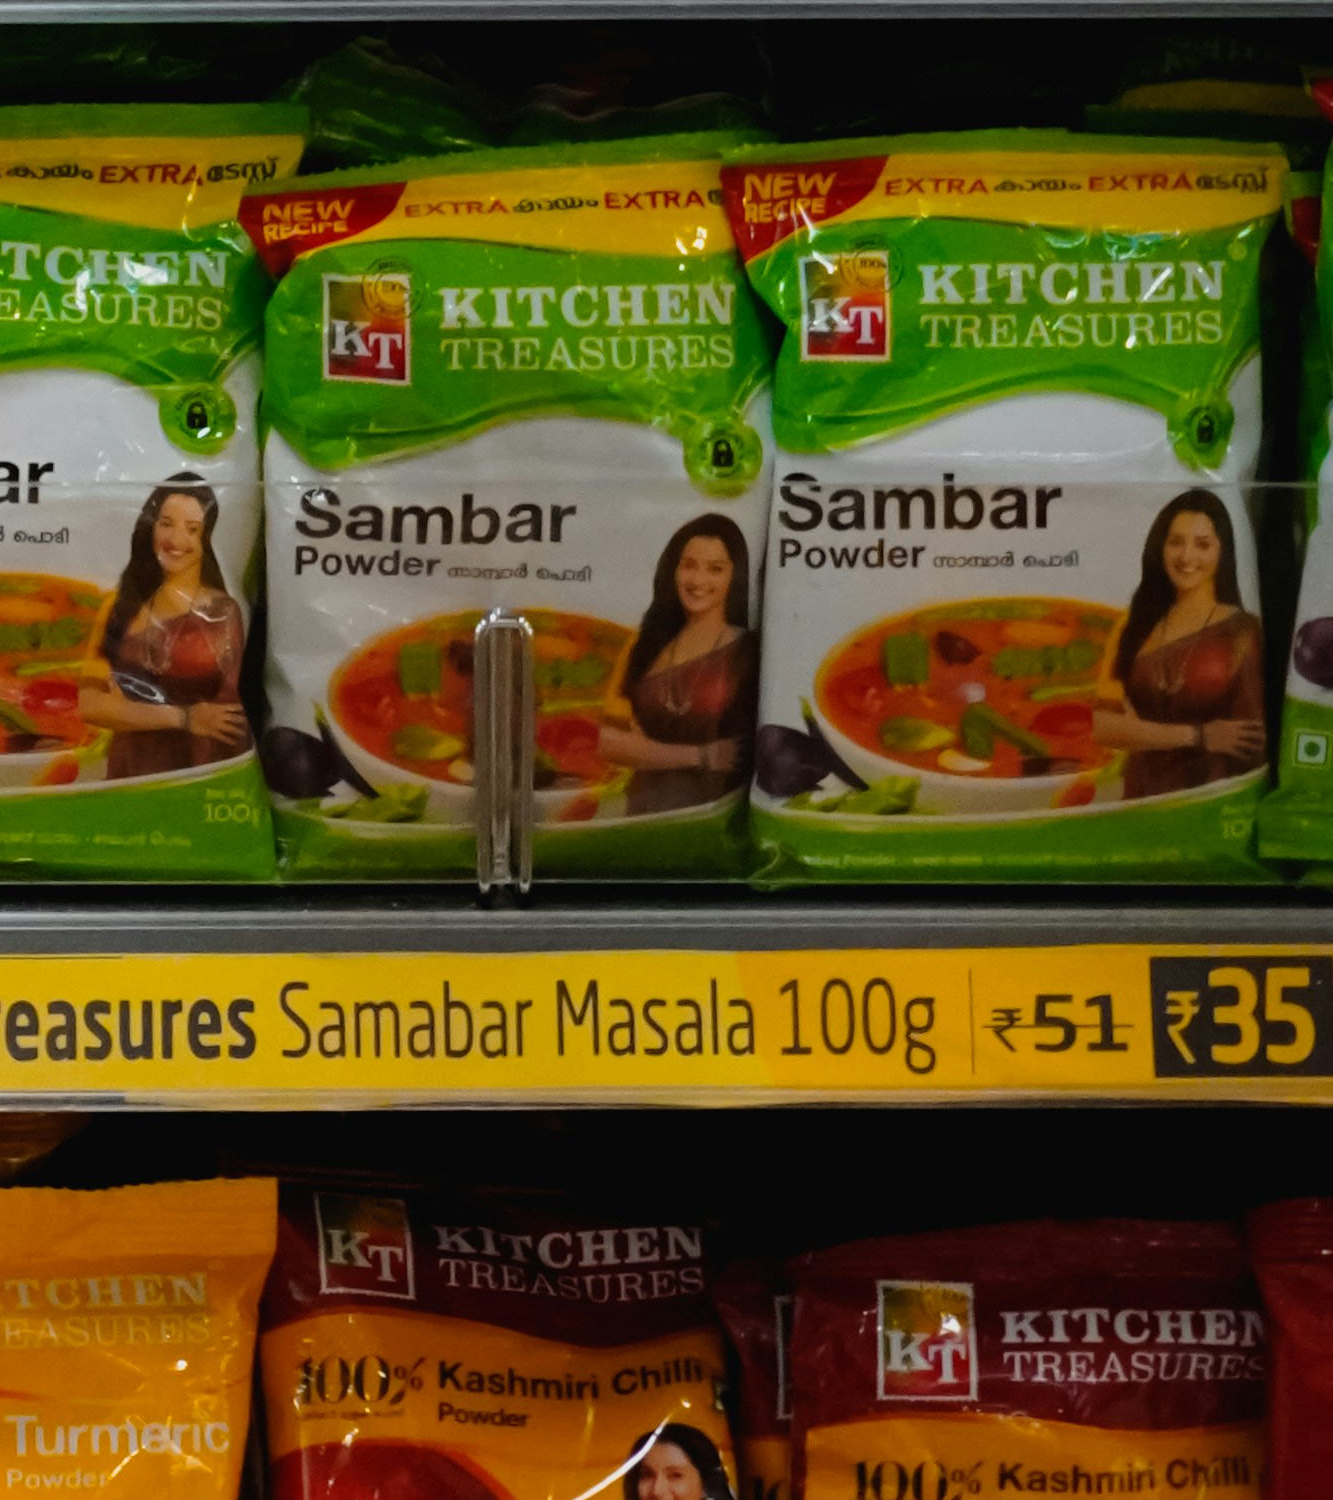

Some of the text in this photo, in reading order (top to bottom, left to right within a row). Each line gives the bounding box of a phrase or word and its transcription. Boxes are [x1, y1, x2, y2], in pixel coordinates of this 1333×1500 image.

[100, 162, 204, 184] EXTRA
[263, 199, 355, 225] NEW
[263, 216, 356, 244] RECIPE
[920, 260, 1225, 306] KITCHEN
[922, 310, 1223, 348] TREASURES
[293, 488, 576, 544] Sambar
[779, 472, 1062, 533] Sambar
[779, 536, 924, 571] Powder
[279, 979, 532, 1058] Samabar
[555, 978, 756, 1058] Masala
[779, 975, 936, 1074] 100g
[1164, 965, 1317, 1066] ₹35
[435, 1224, 704, 1267] KITCHEN
[437, 1256, 706, 1303] TREASURES
[437, 1356, 703, 1399] Kashmiri Chilli
[5, 1412, 231, 1457] Turmeric
[437, 1403, 529, 1431] Powder
[5, 1466, 117, 1493] Powder
